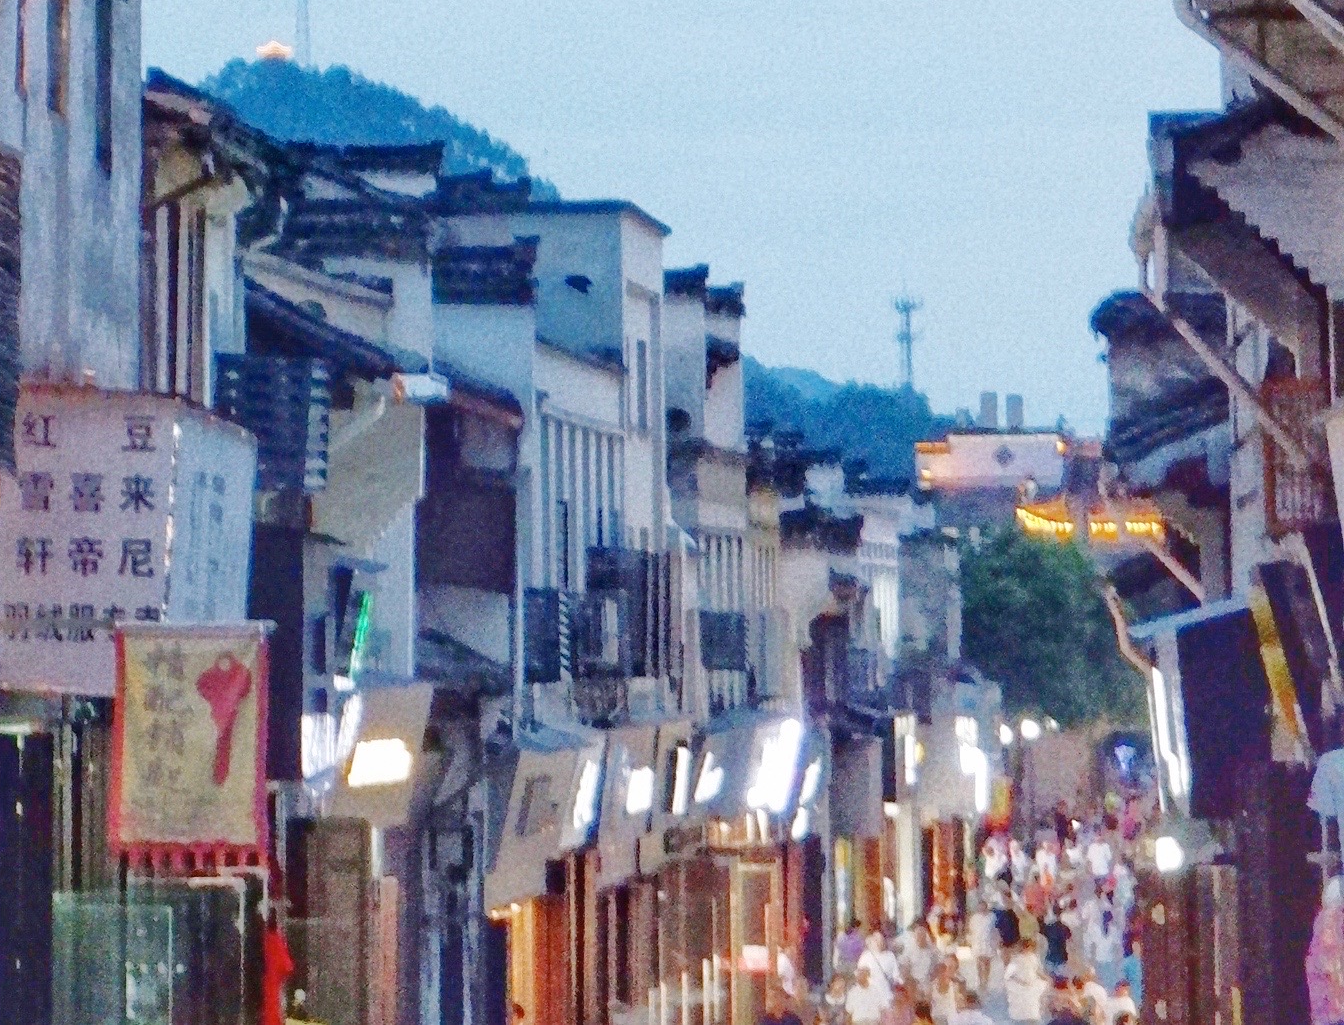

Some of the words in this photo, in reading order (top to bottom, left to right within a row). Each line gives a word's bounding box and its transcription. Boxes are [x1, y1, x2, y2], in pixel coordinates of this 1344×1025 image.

[22, 412, 156, 452] 红豆
[16, 536, 155, 578] 轩帝尼
